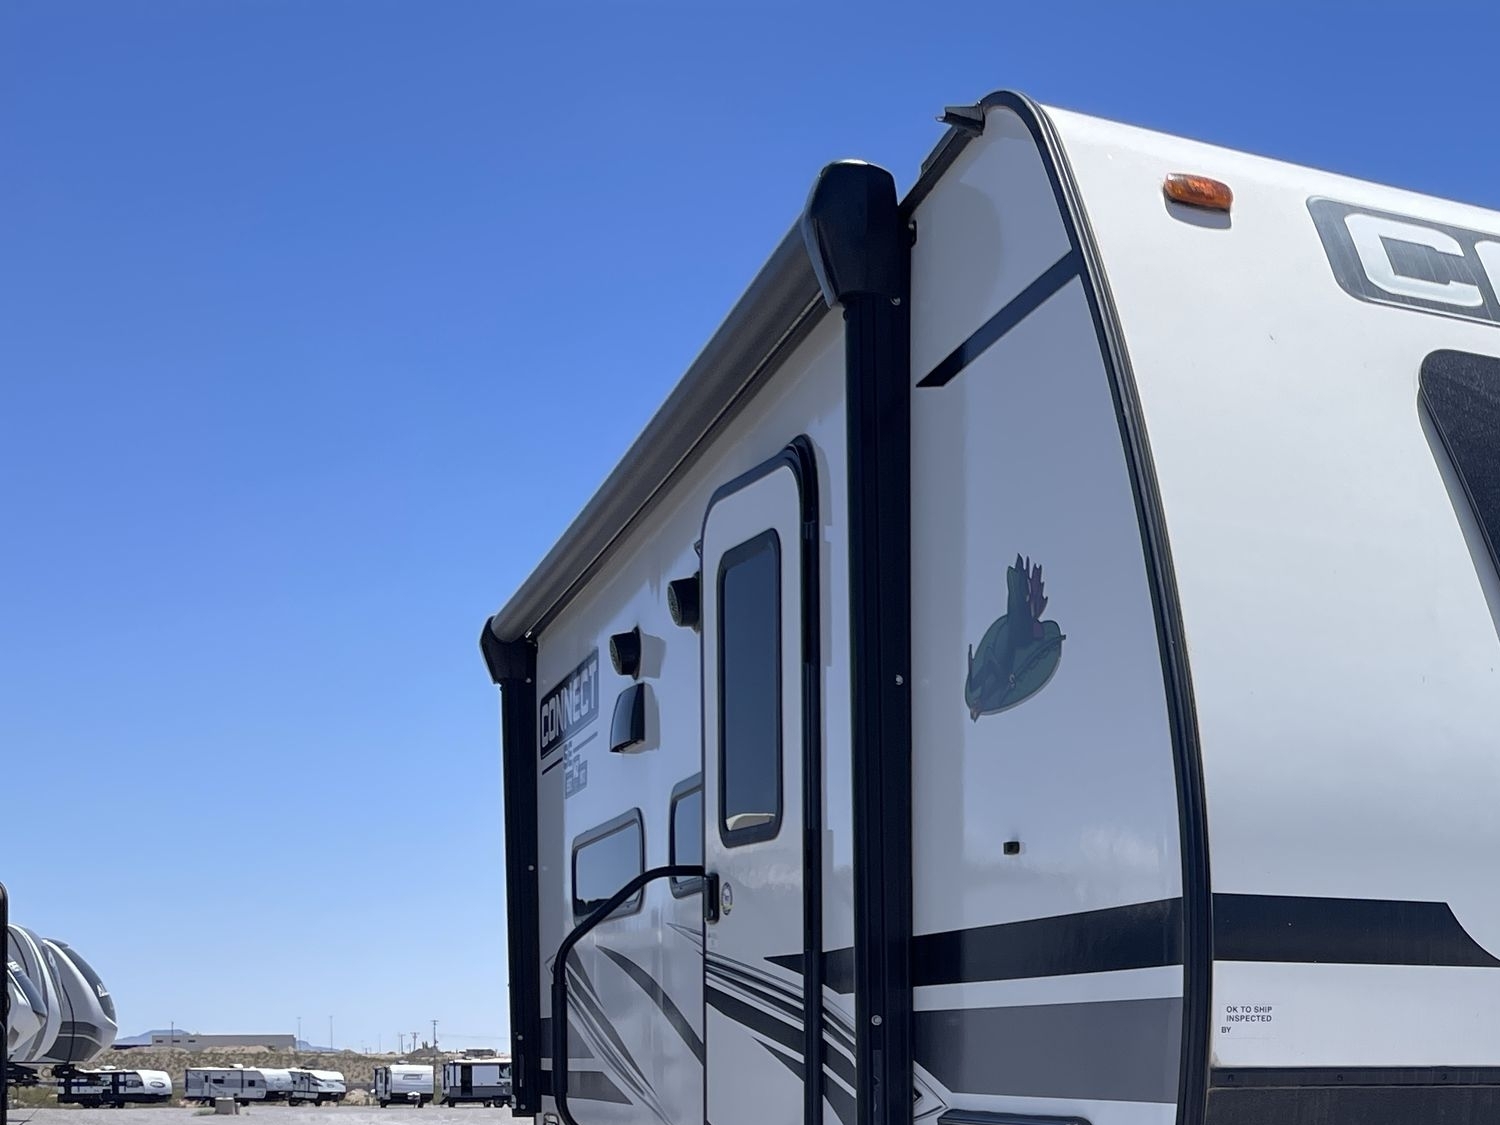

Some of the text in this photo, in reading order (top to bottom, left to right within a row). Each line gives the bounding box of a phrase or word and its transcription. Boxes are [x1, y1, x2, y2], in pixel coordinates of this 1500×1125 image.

[541, 659, 597, 748] CONNECT
[1226, 1005, 1272, 1013] OK TO SHIP
[1226, 1014, 1272, 1022] INSPECTED
[1221, 1026, 1231, 1034] BY
